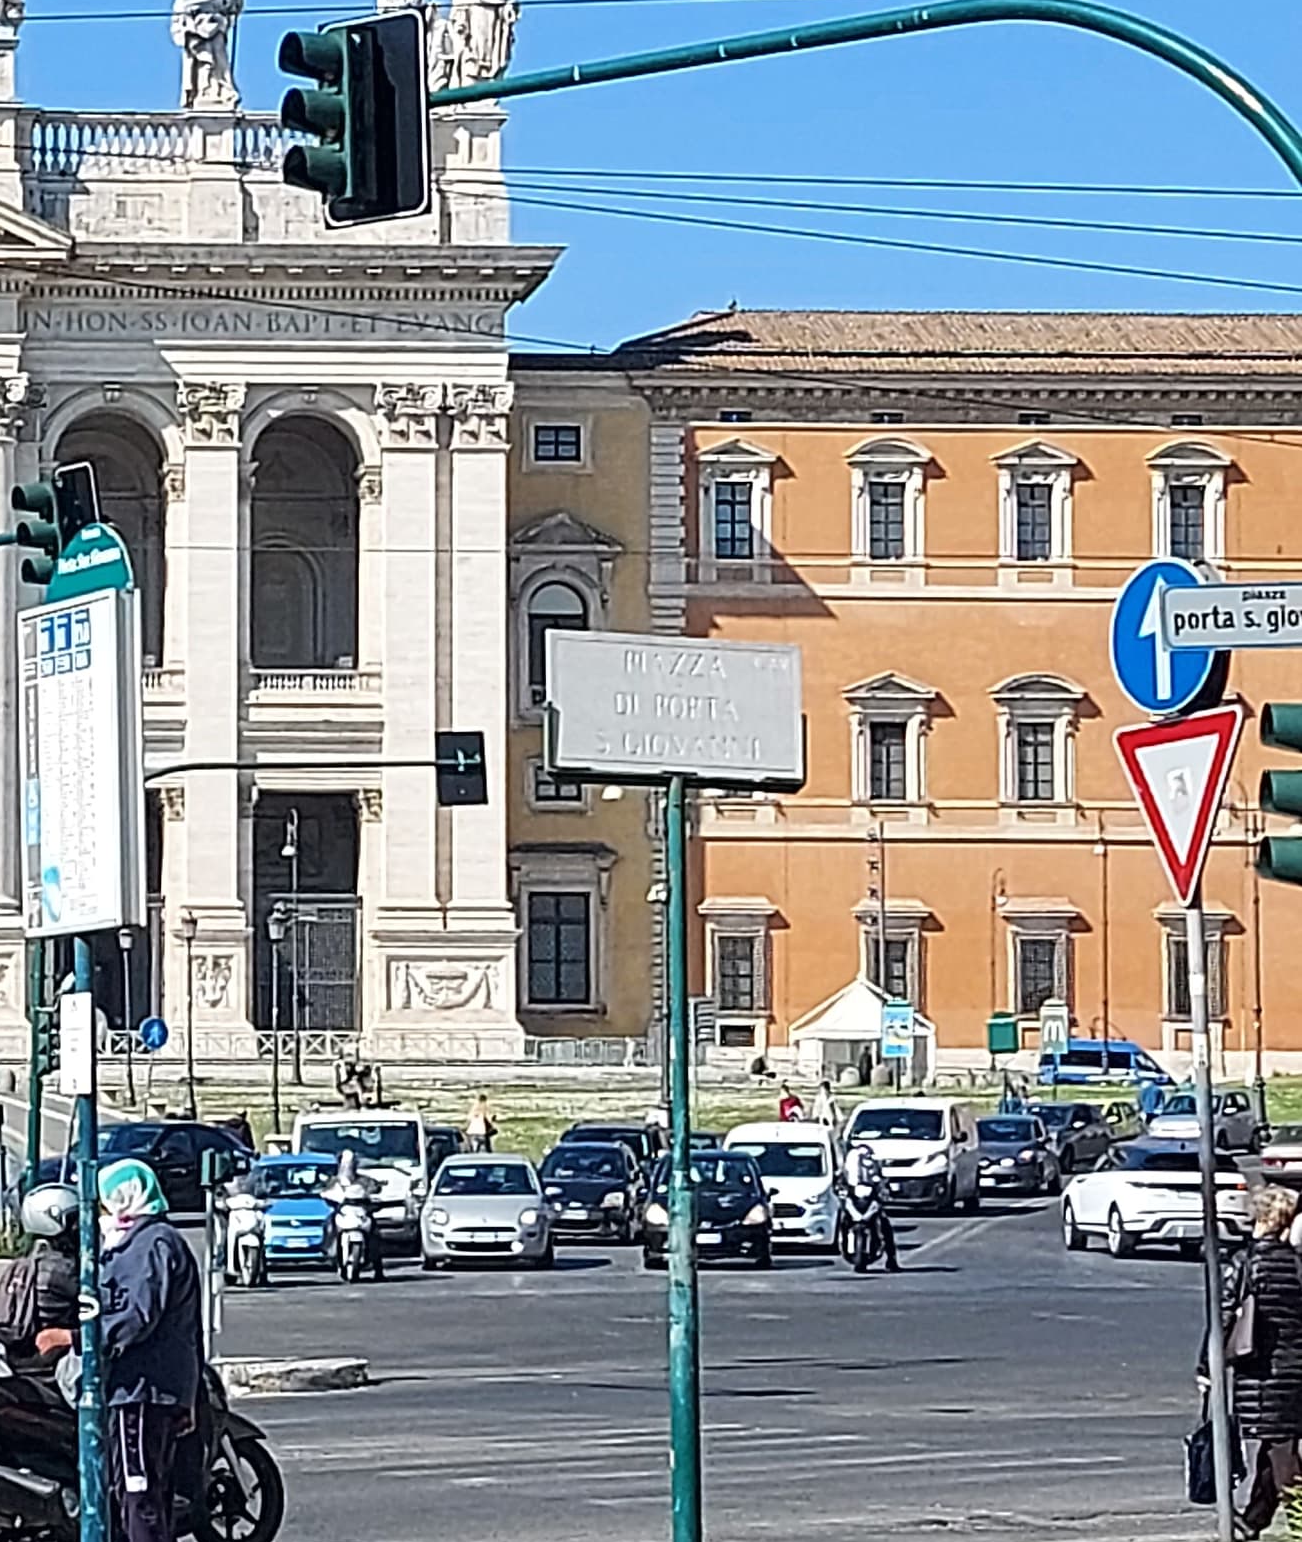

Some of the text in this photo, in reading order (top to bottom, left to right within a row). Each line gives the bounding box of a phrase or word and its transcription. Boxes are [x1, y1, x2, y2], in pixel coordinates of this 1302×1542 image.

[66, 311, 127, 332] HON
[140, 311, 167, 332] SS
[1174, 604, 1302, 636] porta s. gio
[624, 649, 727, 679] PIAZZA
[614, 692, 740, 723] DI PORTA
